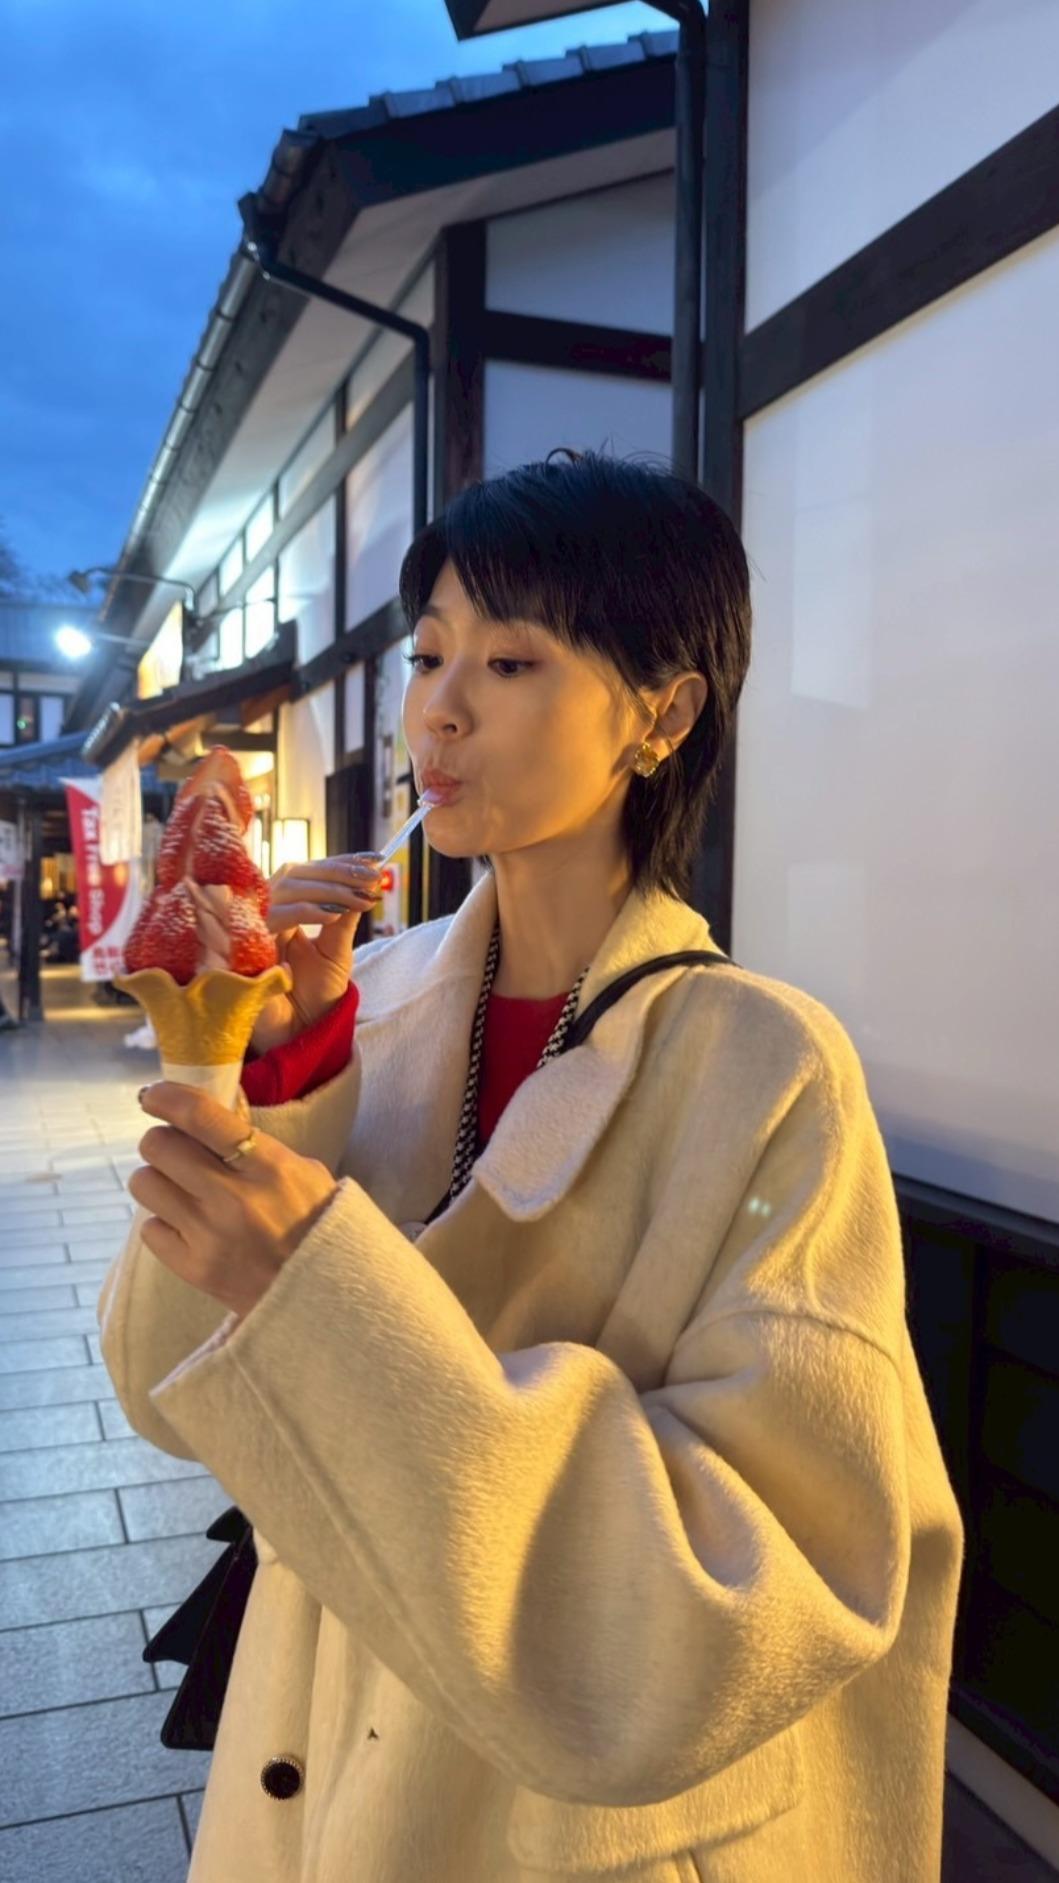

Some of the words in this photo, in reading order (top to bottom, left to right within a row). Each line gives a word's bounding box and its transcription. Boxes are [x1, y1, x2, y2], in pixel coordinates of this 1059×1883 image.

[81, 807, 100, 840] Tax
[85, 843, 101, 886] Free
[88, 888, 105, 935] Shop
